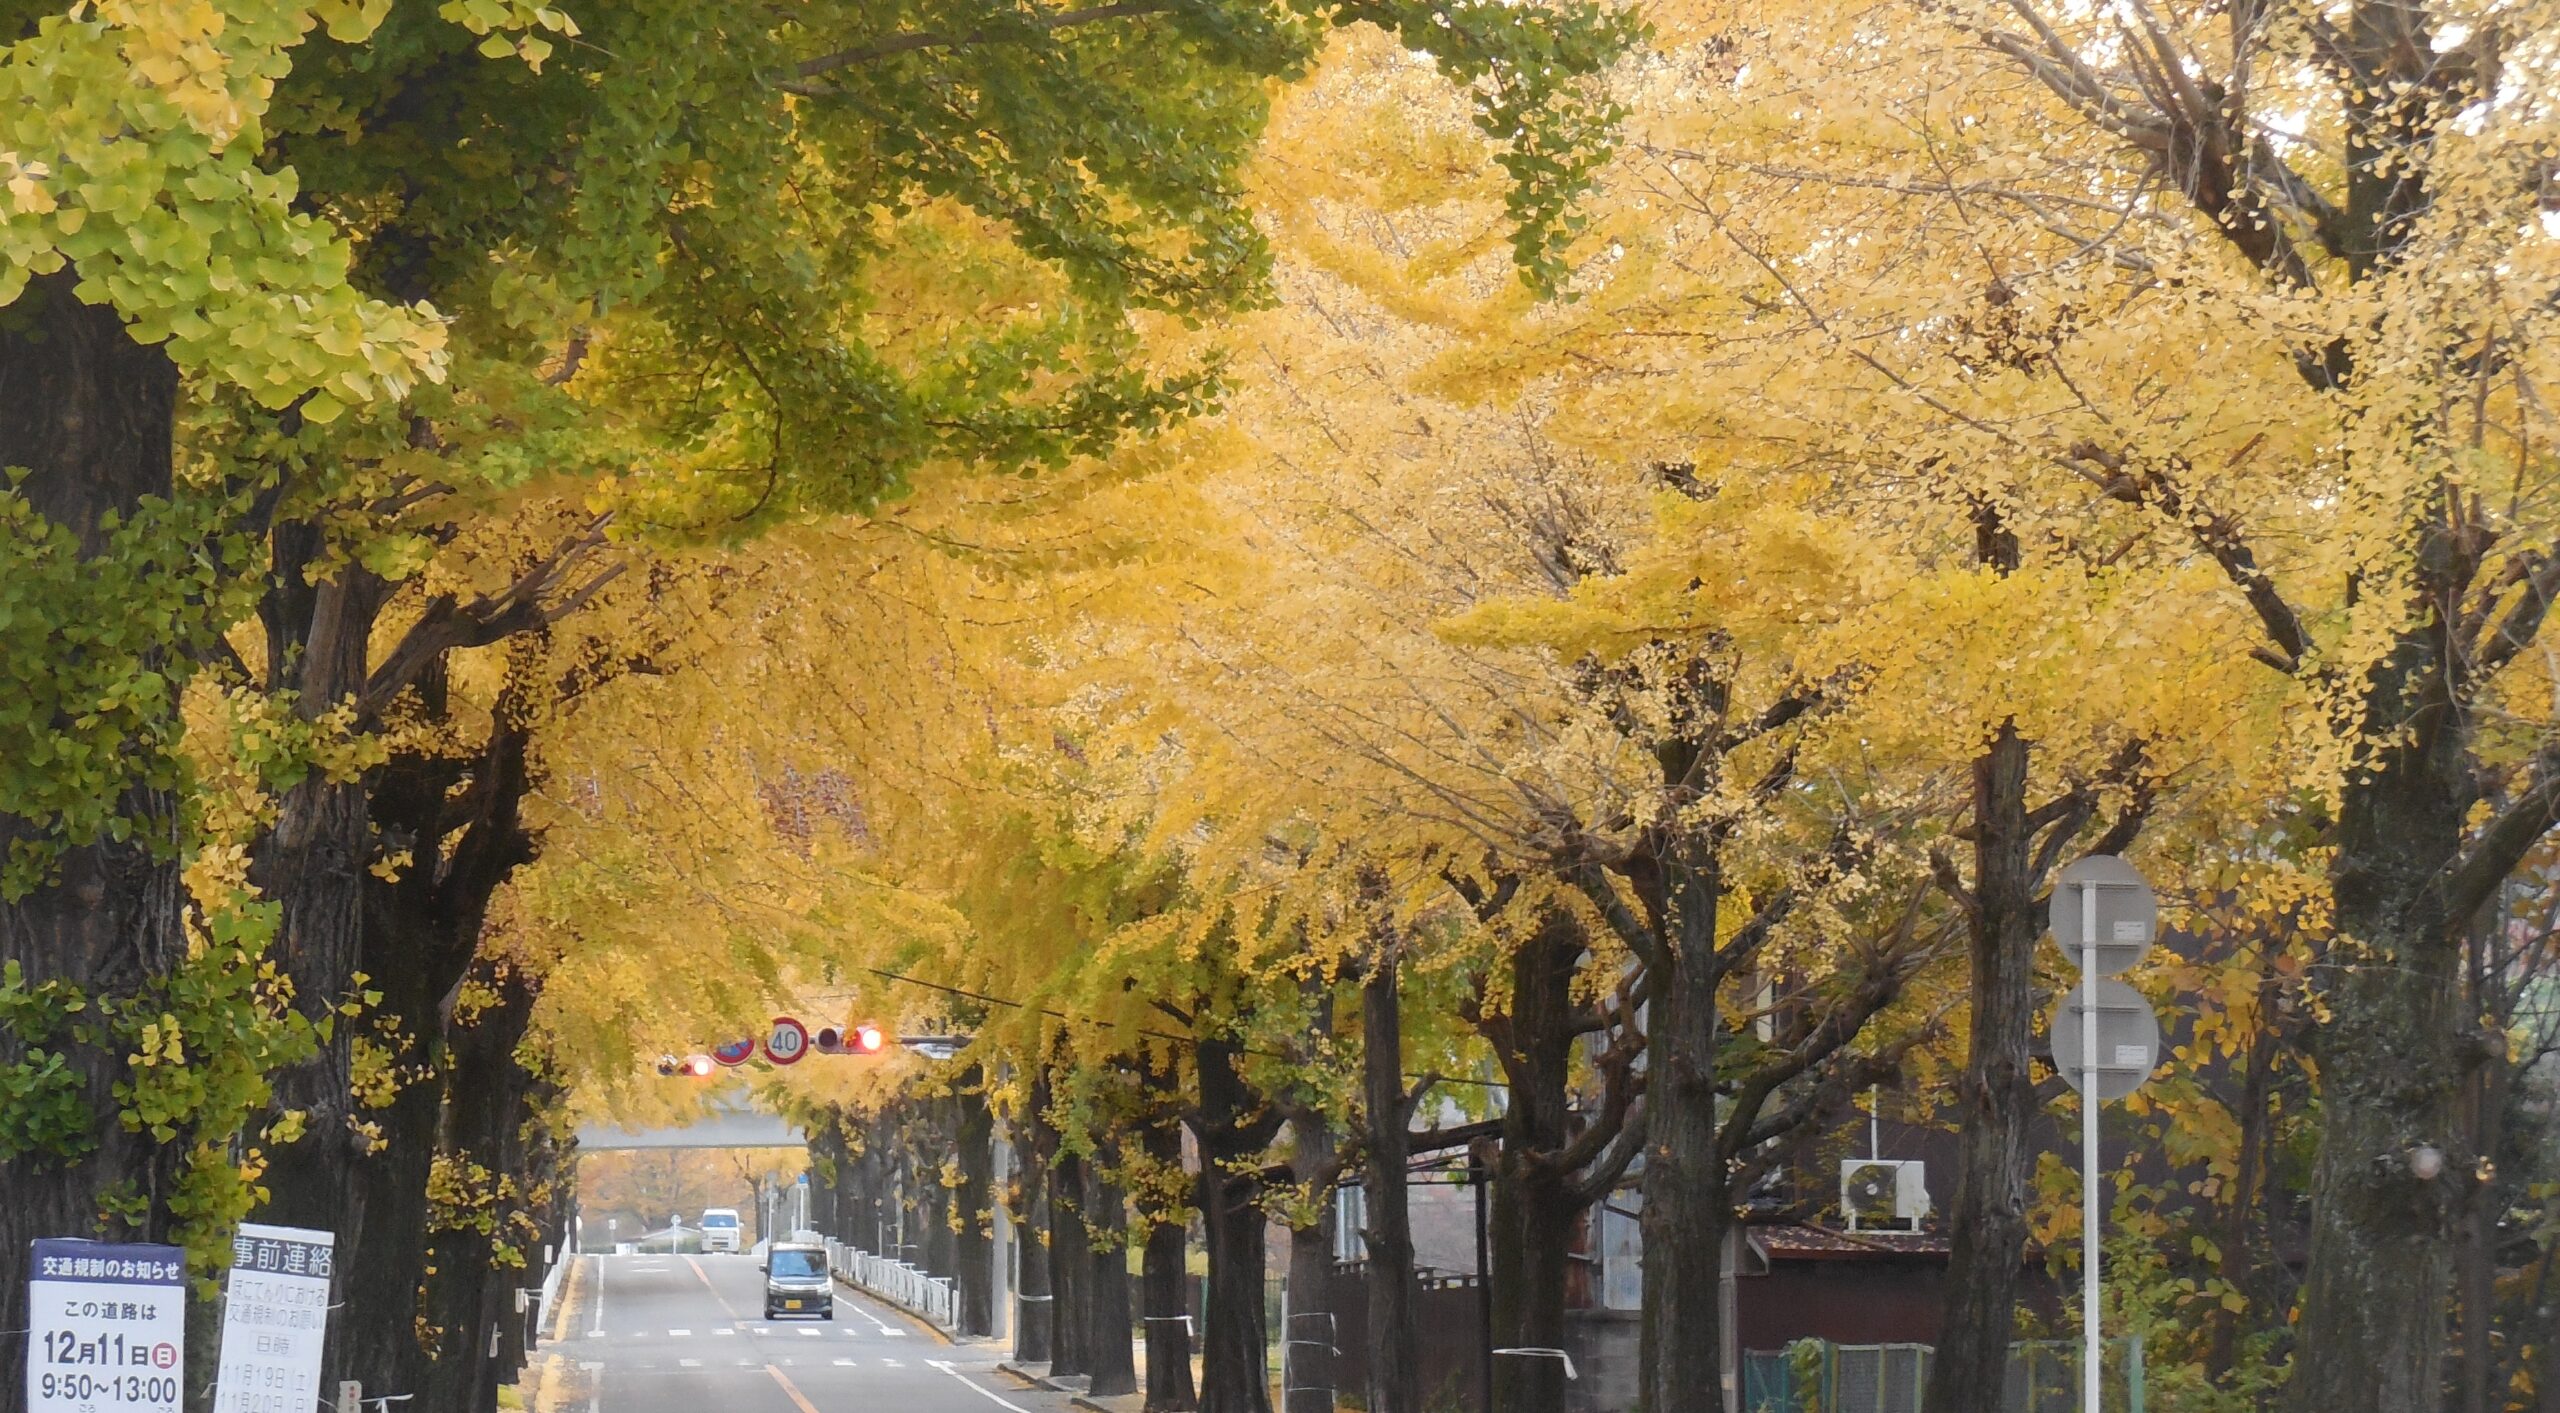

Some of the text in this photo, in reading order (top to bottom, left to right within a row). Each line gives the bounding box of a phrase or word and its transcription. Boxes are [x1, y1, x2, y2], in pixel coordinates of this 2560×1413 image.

[772, 1031, 797, 1051] 40
[234, 1238, 332, 1276] 事前連絡
[42, 1256, 180, 1280] 交通規制のお知らせ
[65, 1301, 157, 1320] この道路は
[257, 1335, 290, 1355] 日時
